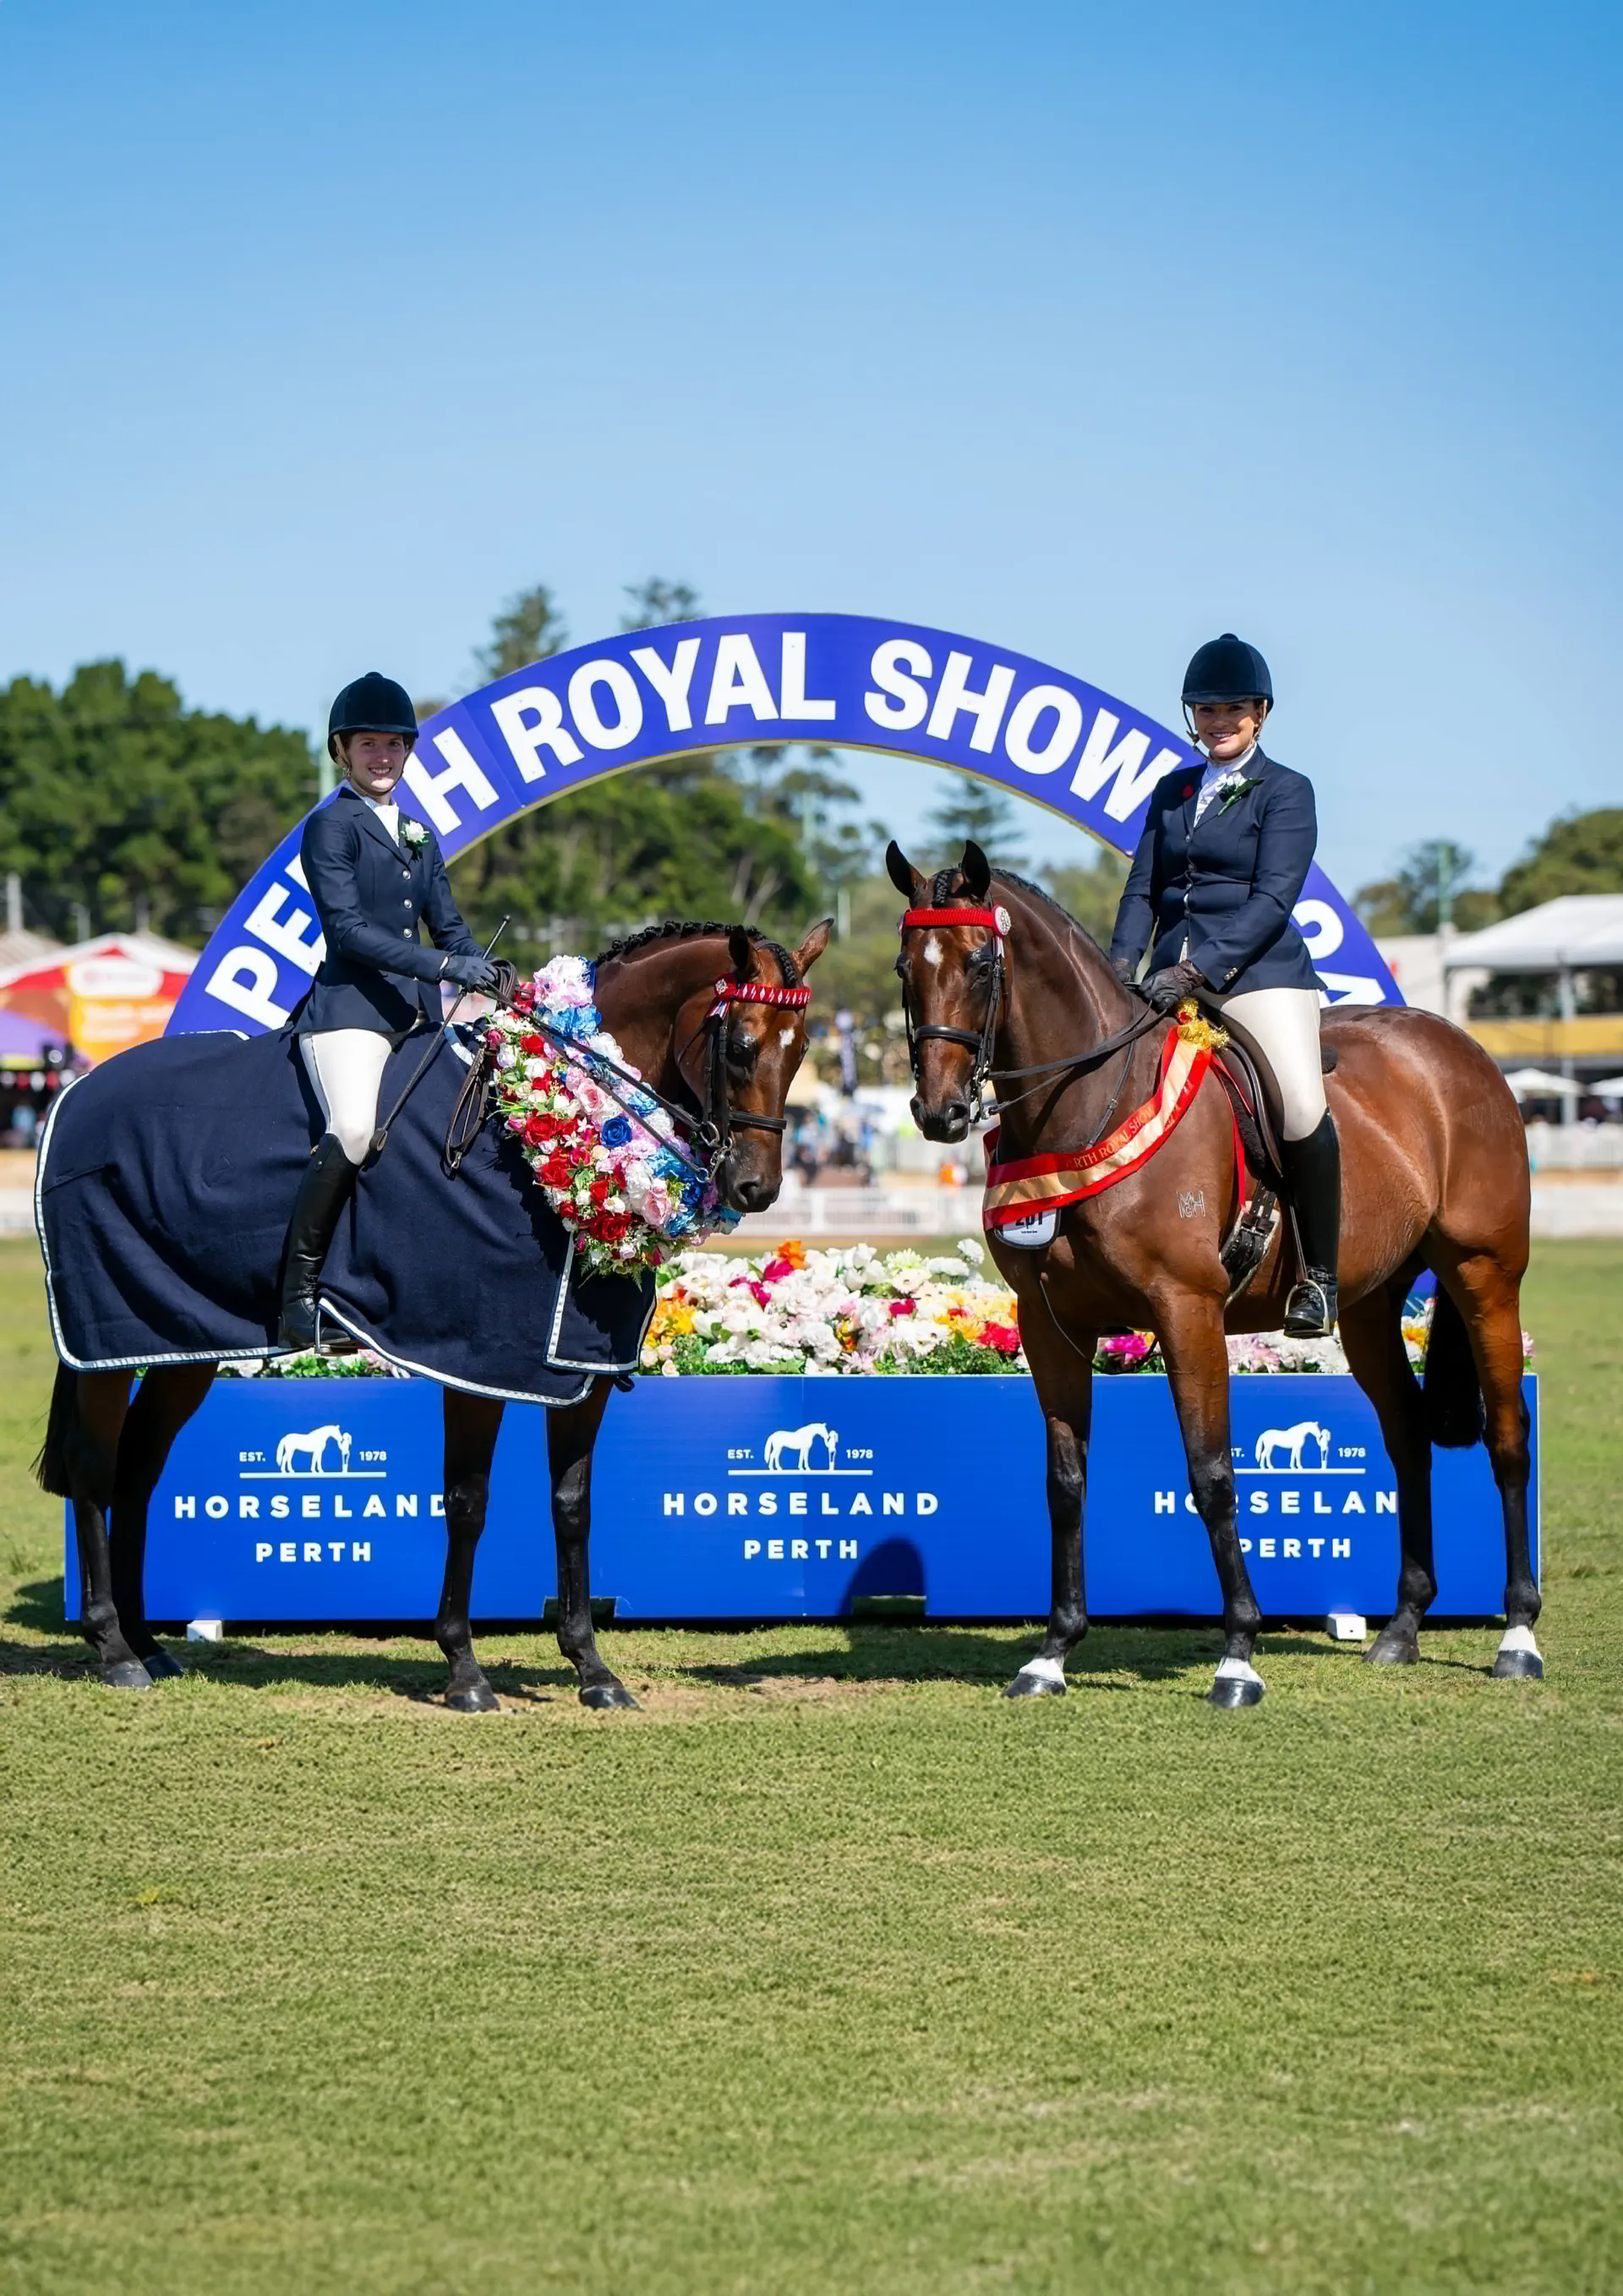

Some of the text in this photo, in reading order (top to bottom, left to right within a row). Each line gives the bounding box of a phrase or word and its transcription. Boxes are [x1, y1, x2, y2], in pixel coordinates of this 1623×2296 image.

[205, 726, 500, 1030] PEH
[489, 632, 835, 784] ROYAL
[864, 639, 1182, 823] SHOW
[1098, 1129, 1131, 1157] ROYAL
[1128, 1105, 1156, 1134] SHOW
[239, 1451, 387, 1462] EST. 1978
[727, 1449, 873, 1459] EST. 1978
[1338, 1447, 1366, 1457] 1978
[175, 1494, 446, 1518] HORSELAND
[664, 1492, 938, 1516] HORSELAND
[1155, 1490, 1397, 1514] HSELAN
[256, 1542, 372, 1562] PERTH
[744, 1539, 857, 1560] PERTH
